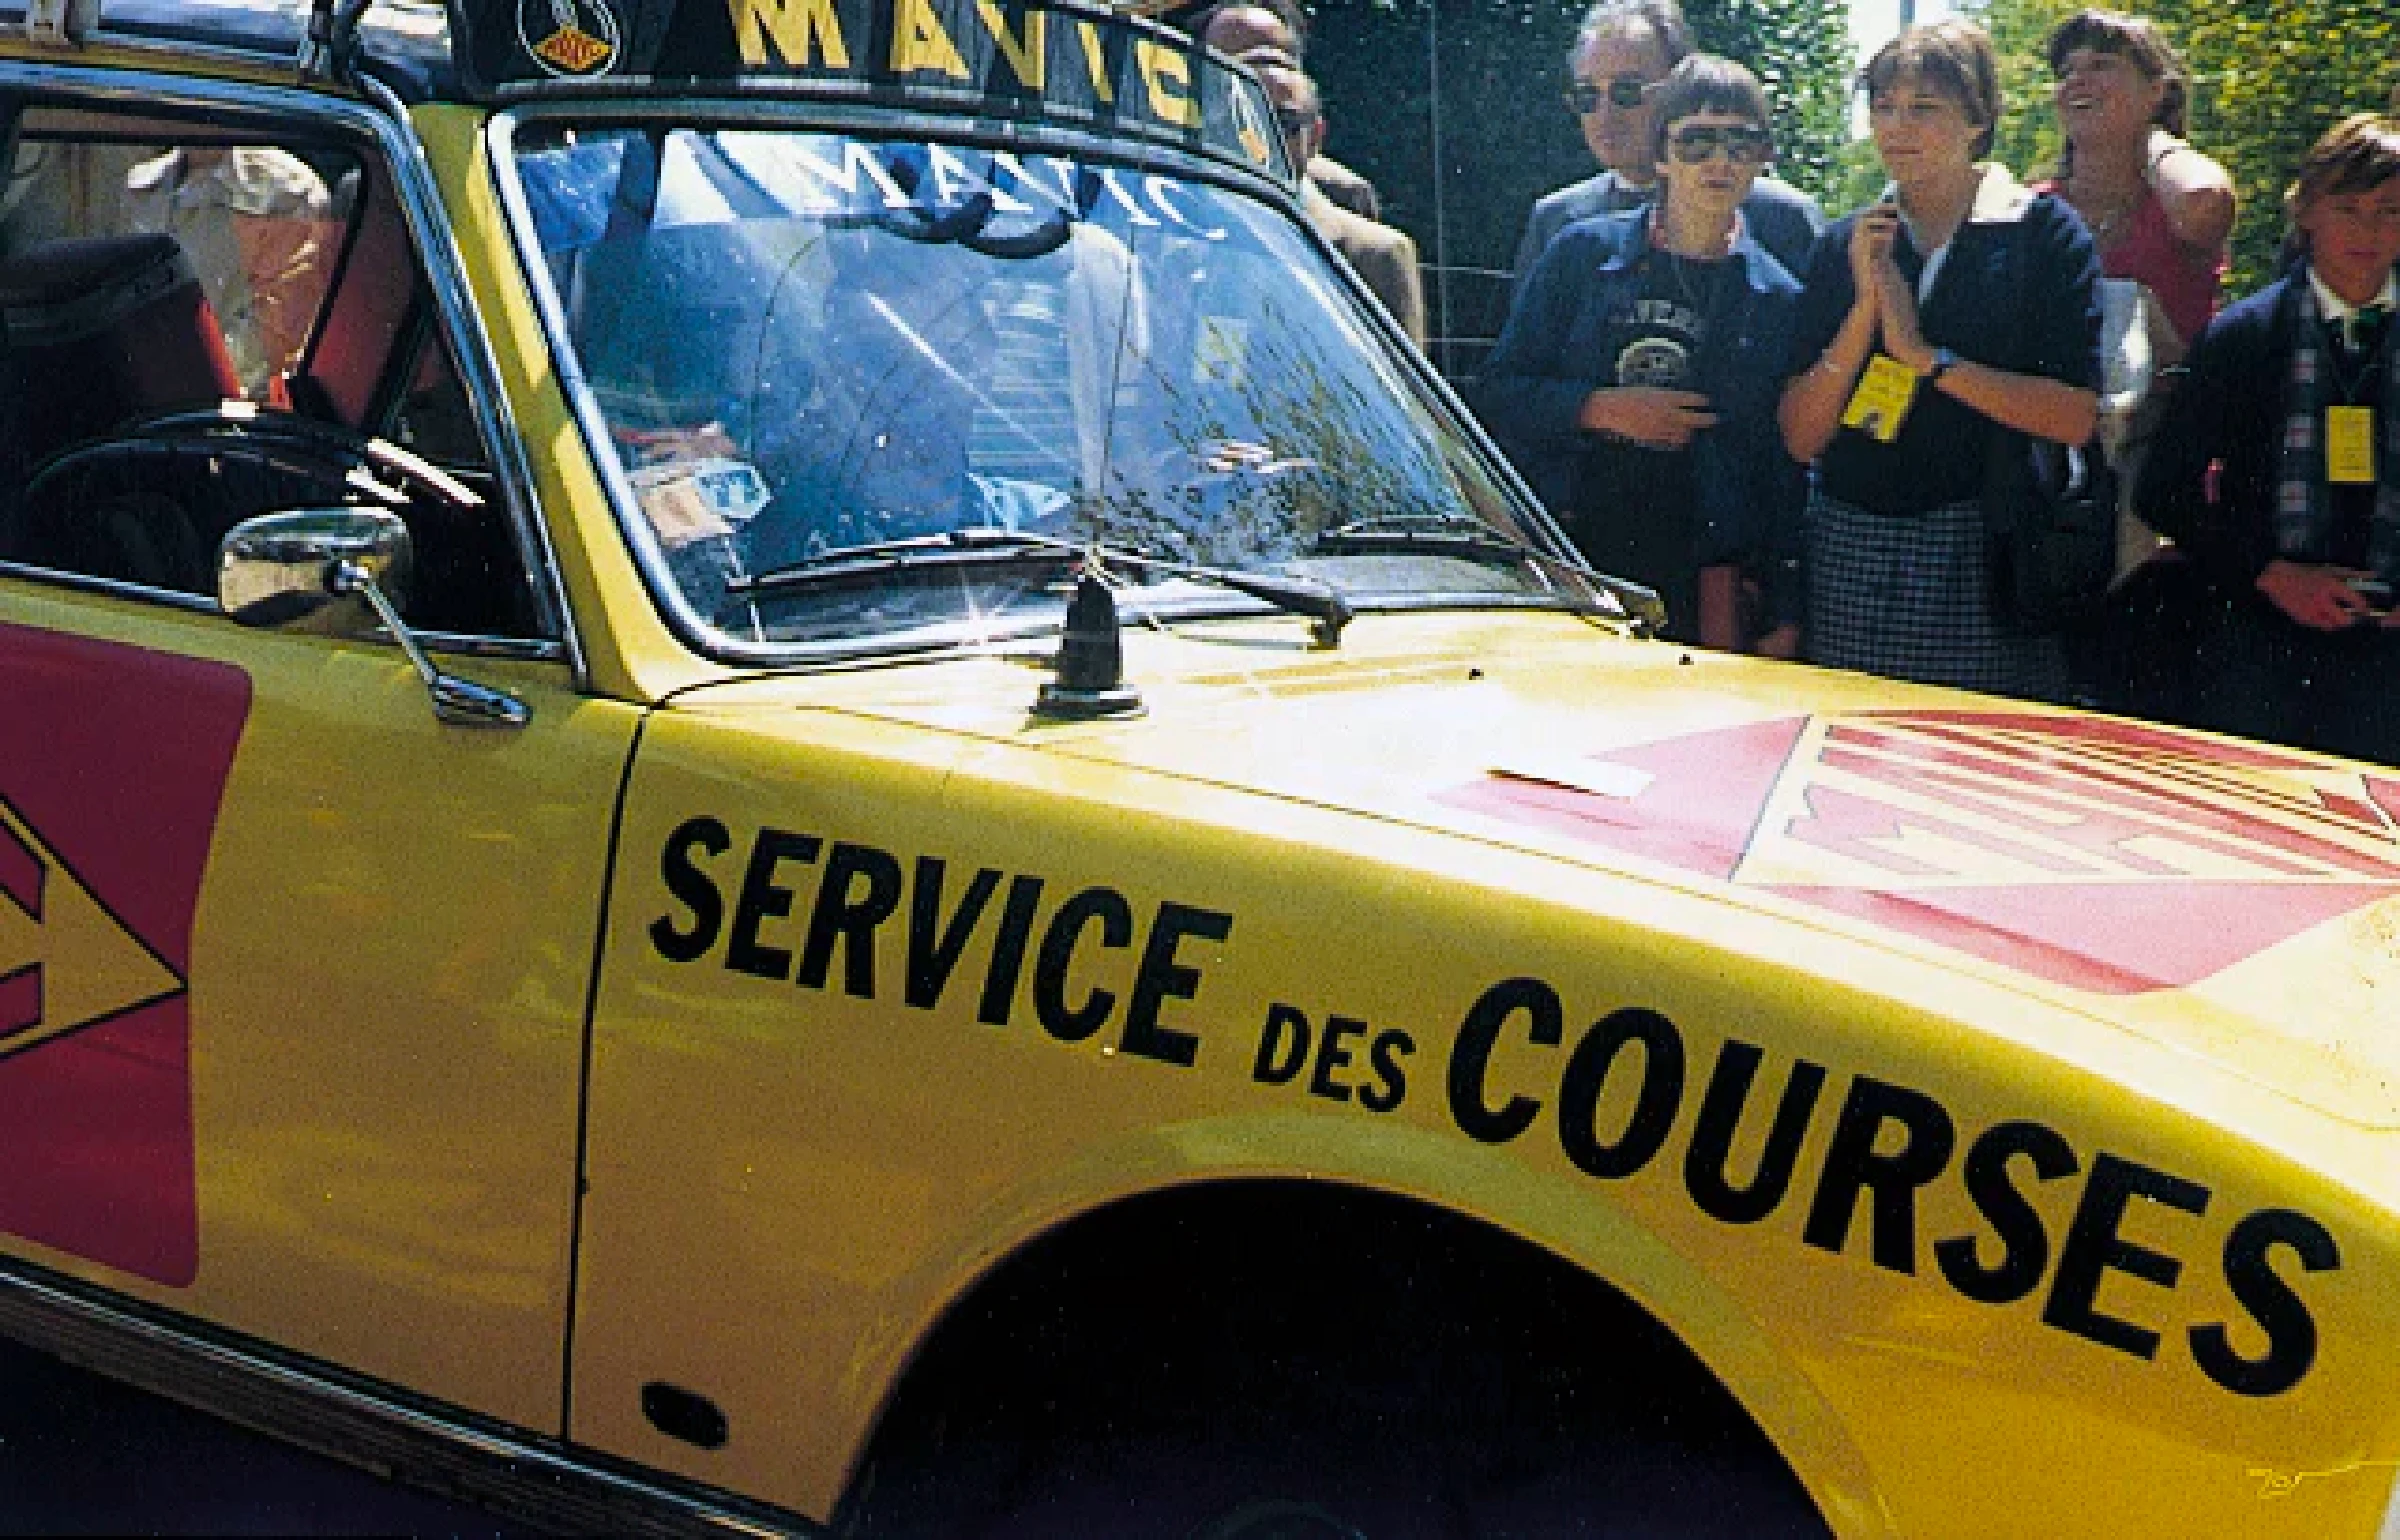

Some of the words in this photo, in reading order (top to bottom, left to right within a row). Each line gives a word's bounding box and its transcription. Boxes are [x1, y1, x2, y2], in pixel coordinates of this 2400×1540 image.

[735, 0, 1202, 128] MAVIC
[788, 142, 1228, 243] MAVIC
[649, 813, 1234, 1070] SERVICE
[1253, 1001, 1418, 1113] DES
[1446, 976, 2343, 1398] COURSES
